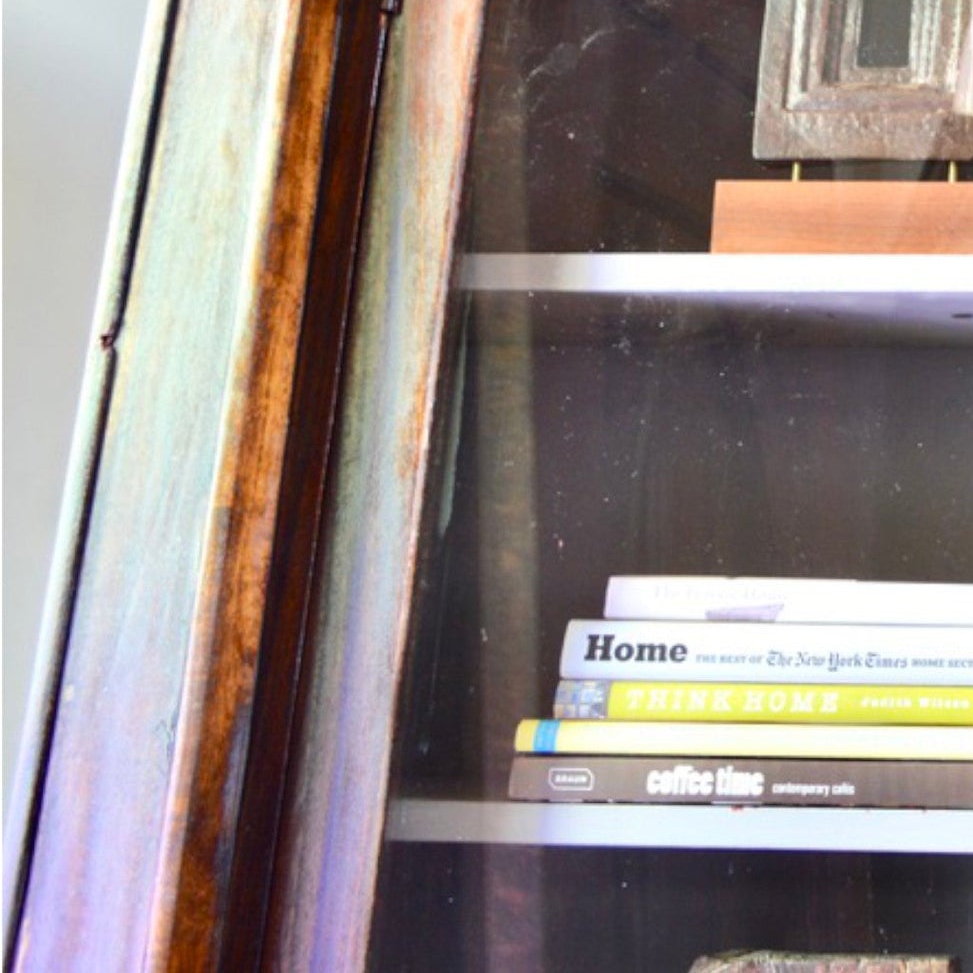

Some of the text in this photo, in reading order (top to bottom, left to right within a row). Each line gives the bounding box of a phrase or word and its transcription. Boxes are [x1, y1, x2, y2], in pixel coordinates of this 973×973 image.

[584, 634, 687, 663] Home
[766, 649, 792, 667] The
[795, 650, 826, 668] New
[827, 651, 863, 672] York
[865, 651, 908, 669] Times
[626, 690, 732, 712] THINK
[744, 692, 839, 713] HOME
[646, 765, 712, 796] coffee
[715, 766, 764, 796] time
